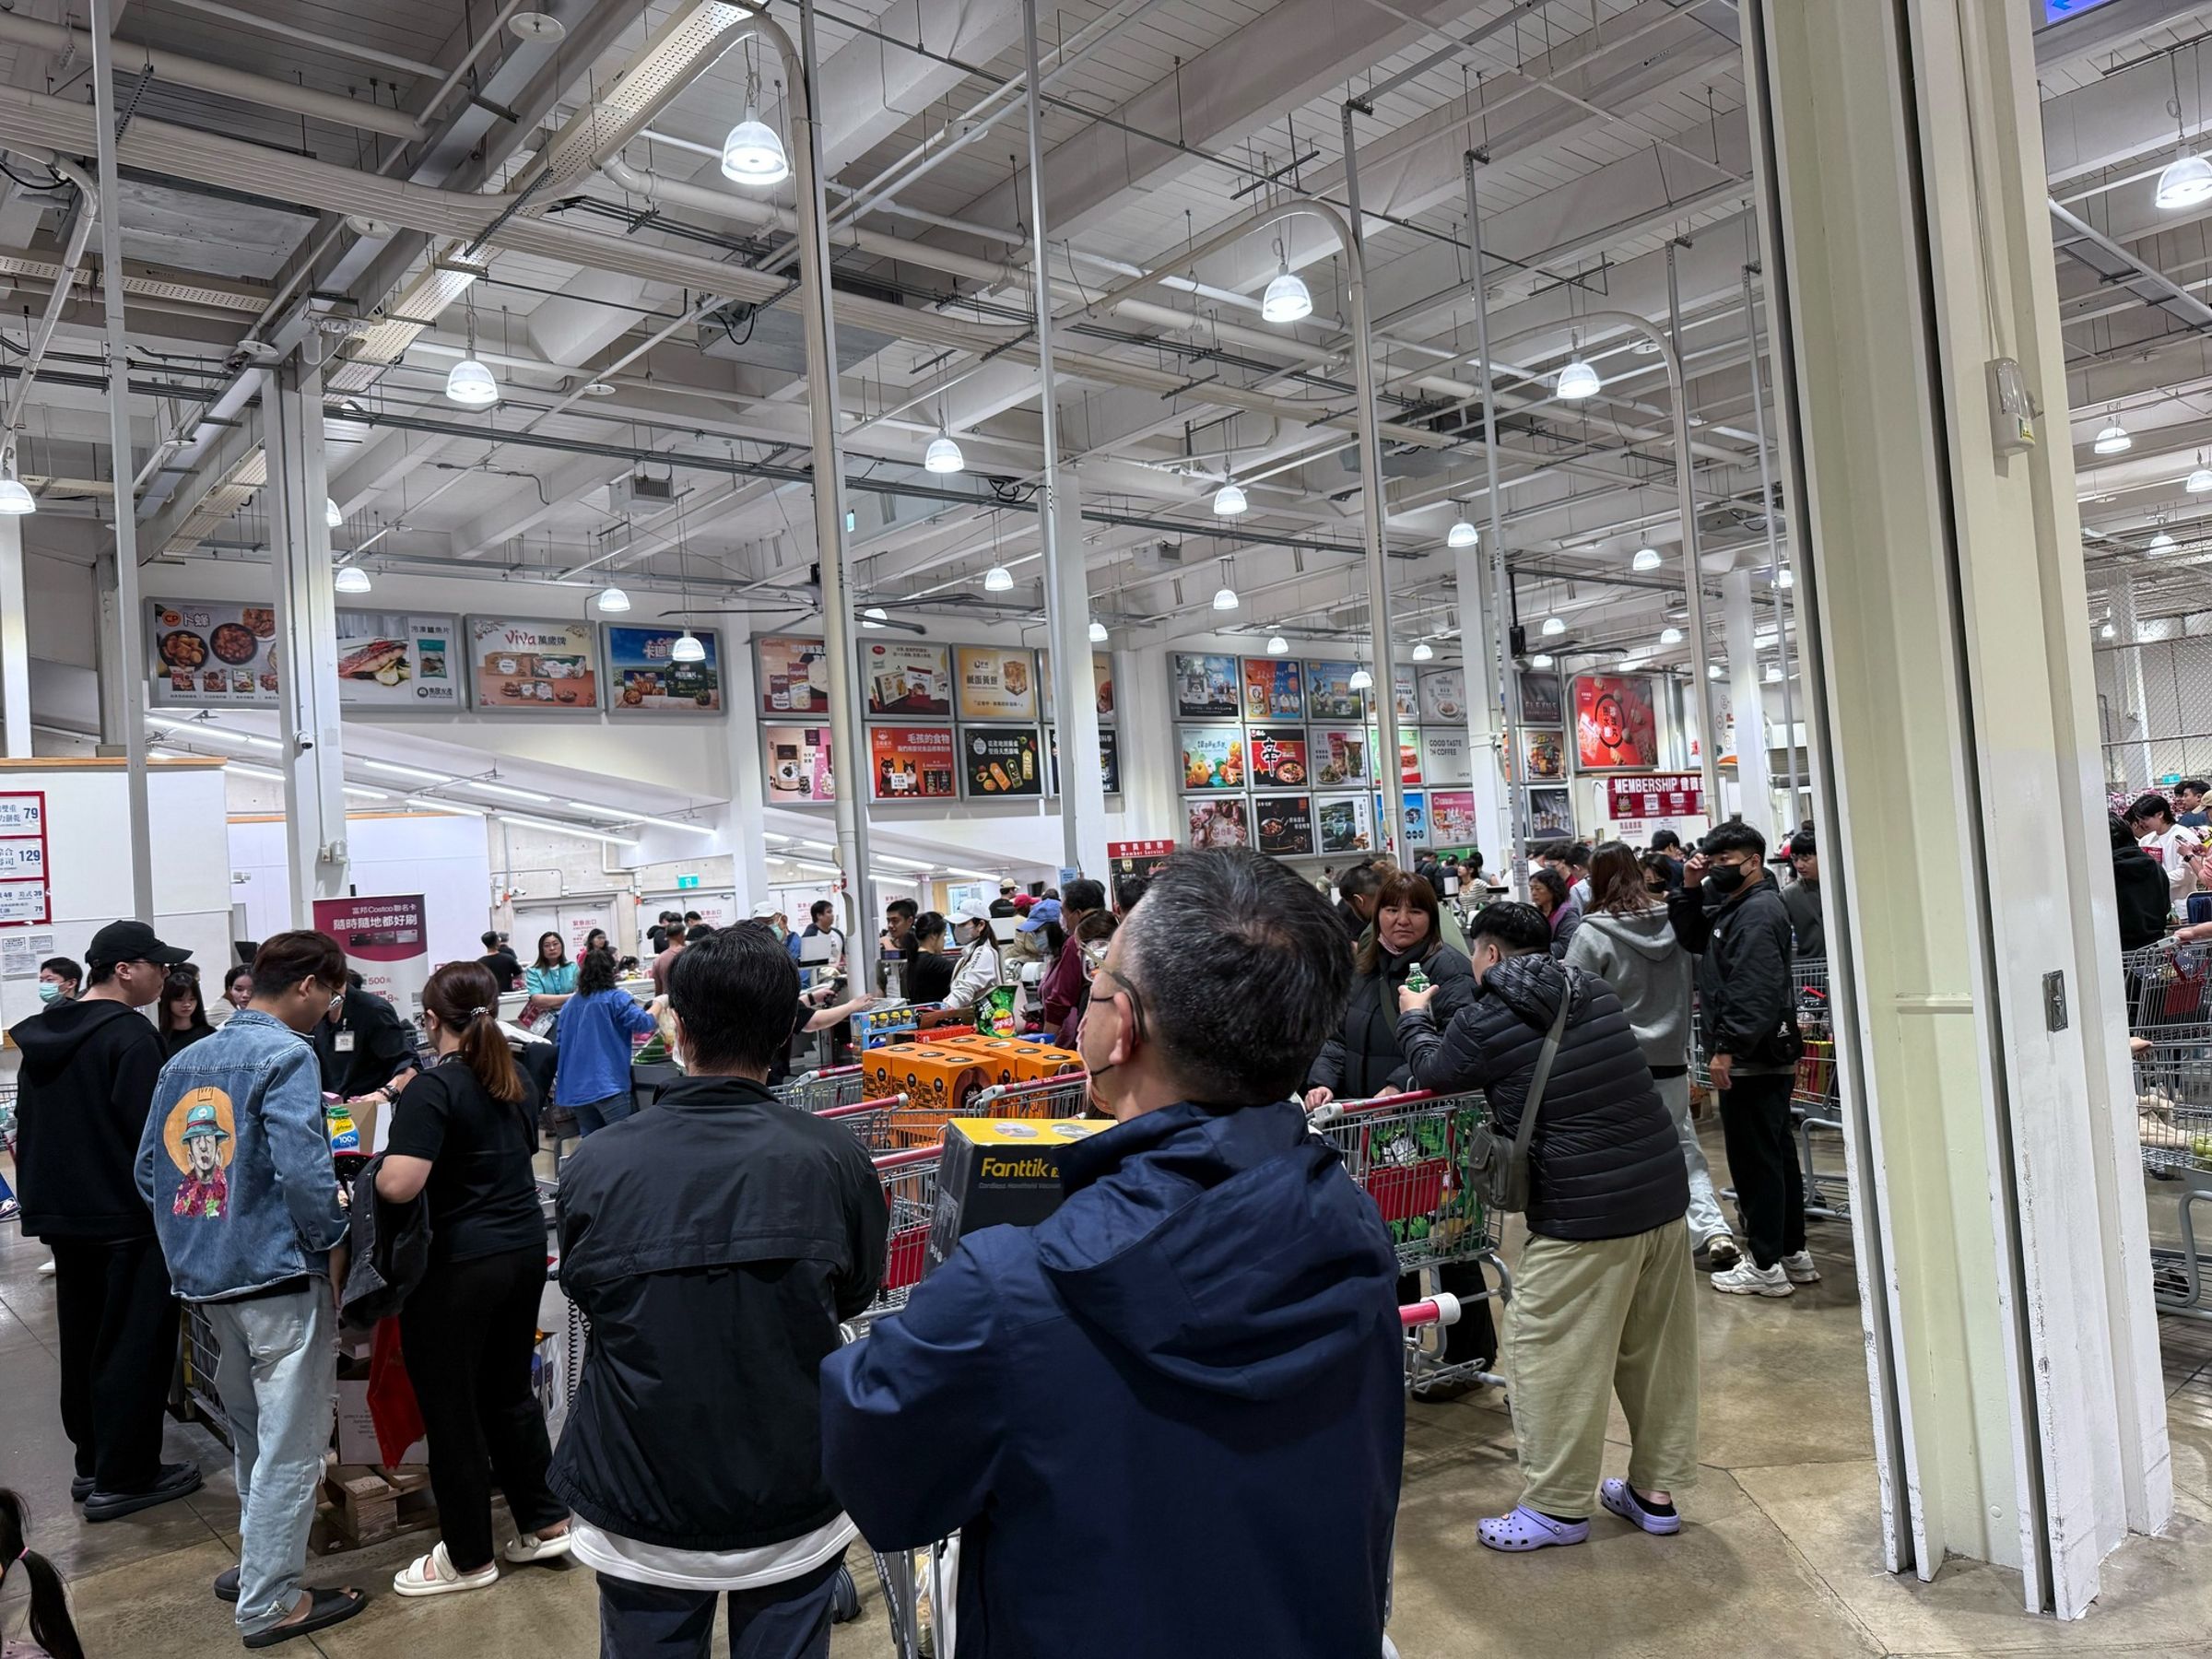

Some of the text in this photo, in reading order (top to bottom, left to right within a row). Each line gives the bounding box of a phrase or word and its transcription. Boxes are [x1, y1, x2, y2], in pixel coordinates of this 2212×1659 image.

[164, 614, 179, 623] CP
[504, 629, 536, 645] Viva
[1260, 736, 1282, 778] 辛
[1614, 777, 1677, 794] MEMBERSHIP
[0, 804, 17, 812] 雙重
[23, 807, 39, 819] 79
[18, 849, 41, 862] 129
[351, 903, 418, 915] 富邦Costco聯名卡
[333, 913, 418, 931] 隨時隨地都好刷
[368, 976, 385, 985] 500
[981, 1157, 1050, 1177] Fanttik
